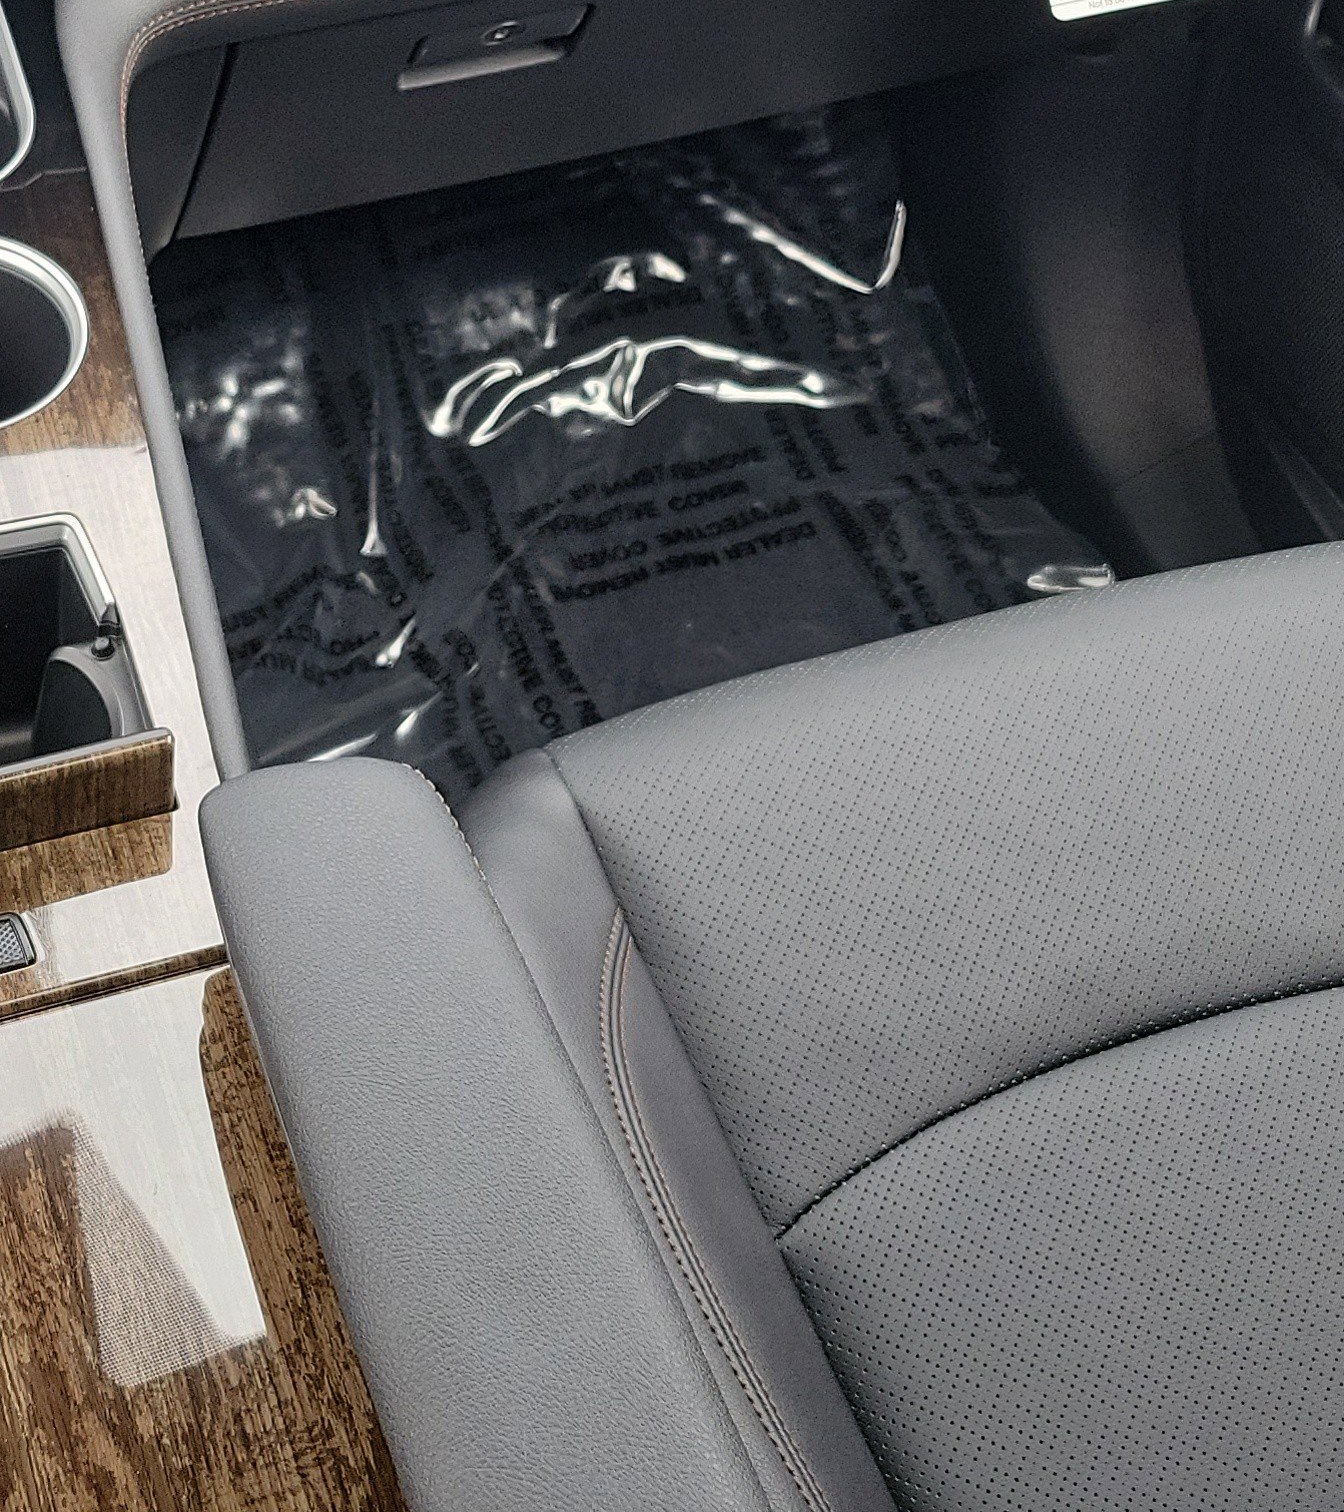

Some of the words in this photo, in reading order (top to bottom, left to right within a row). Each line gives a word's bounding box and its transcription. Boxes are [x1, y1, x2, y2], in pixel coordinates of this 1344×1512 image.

[570, 540, 647, 570] COVER
[722, 522, 816, 559] DEALER
[654, 553, 720, 576] MUST
[550, 568, 648, 603] REMOV
